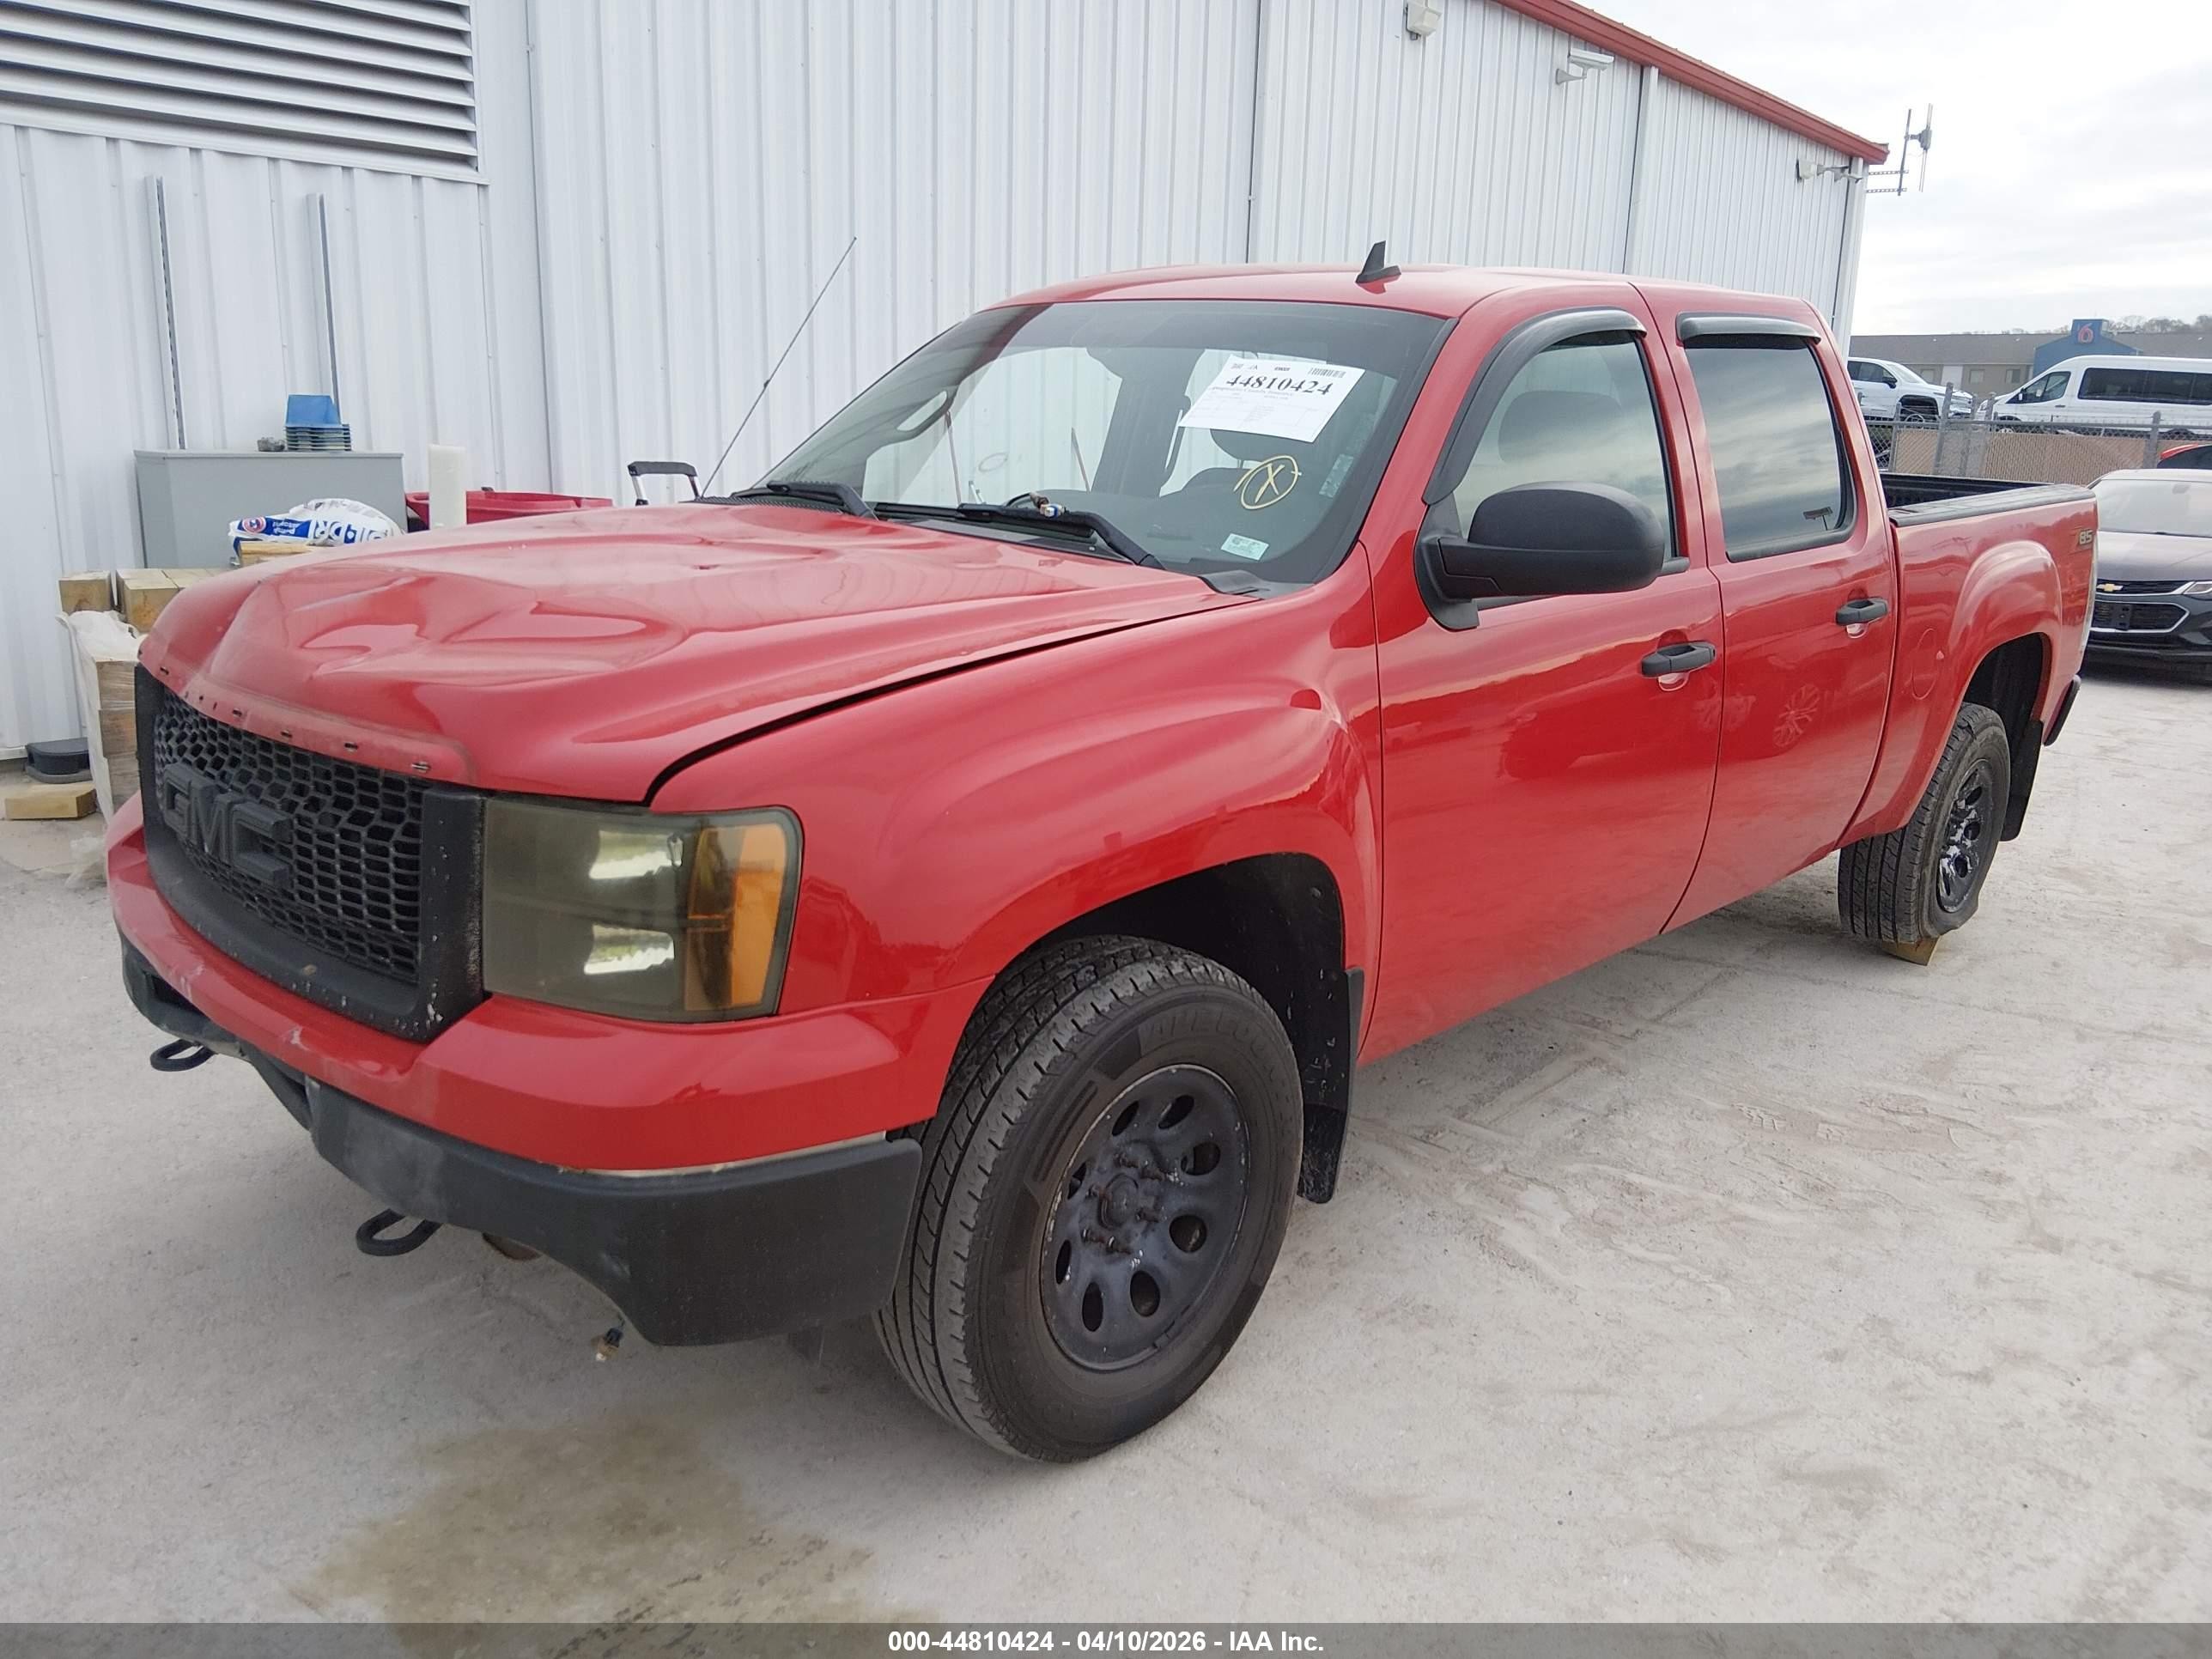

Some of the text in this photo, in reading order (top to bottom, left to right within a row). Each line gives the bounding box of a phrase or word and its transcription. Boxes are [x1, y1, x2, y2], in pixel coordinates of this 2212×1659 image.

[2078, 323, 2094, 343] 6
[1226, 374, 1334, 396] 44810424
[164, 762, 294, 883] GMC
